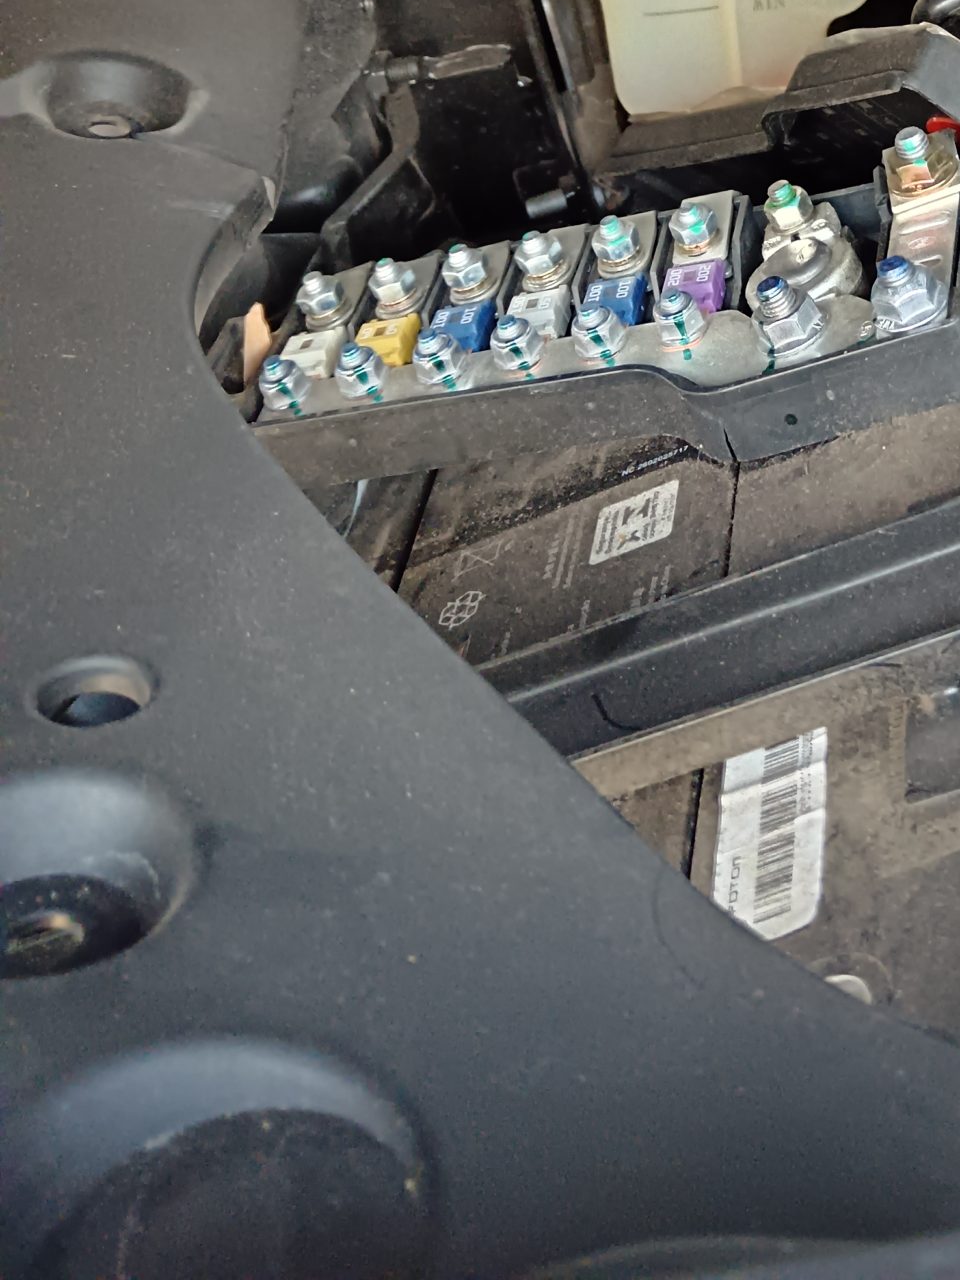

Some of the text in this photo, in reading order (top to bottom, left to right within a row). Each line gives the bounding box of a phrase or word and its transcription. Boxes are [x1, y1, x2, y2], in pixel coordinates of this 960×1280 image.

[696, 264, 711, 282] 200
[588, 284, 603, 302] 100
[616, 280, 632, 299] 100
[433, 311, 450, 328] 100
[460, 306, 478, 324] 100
